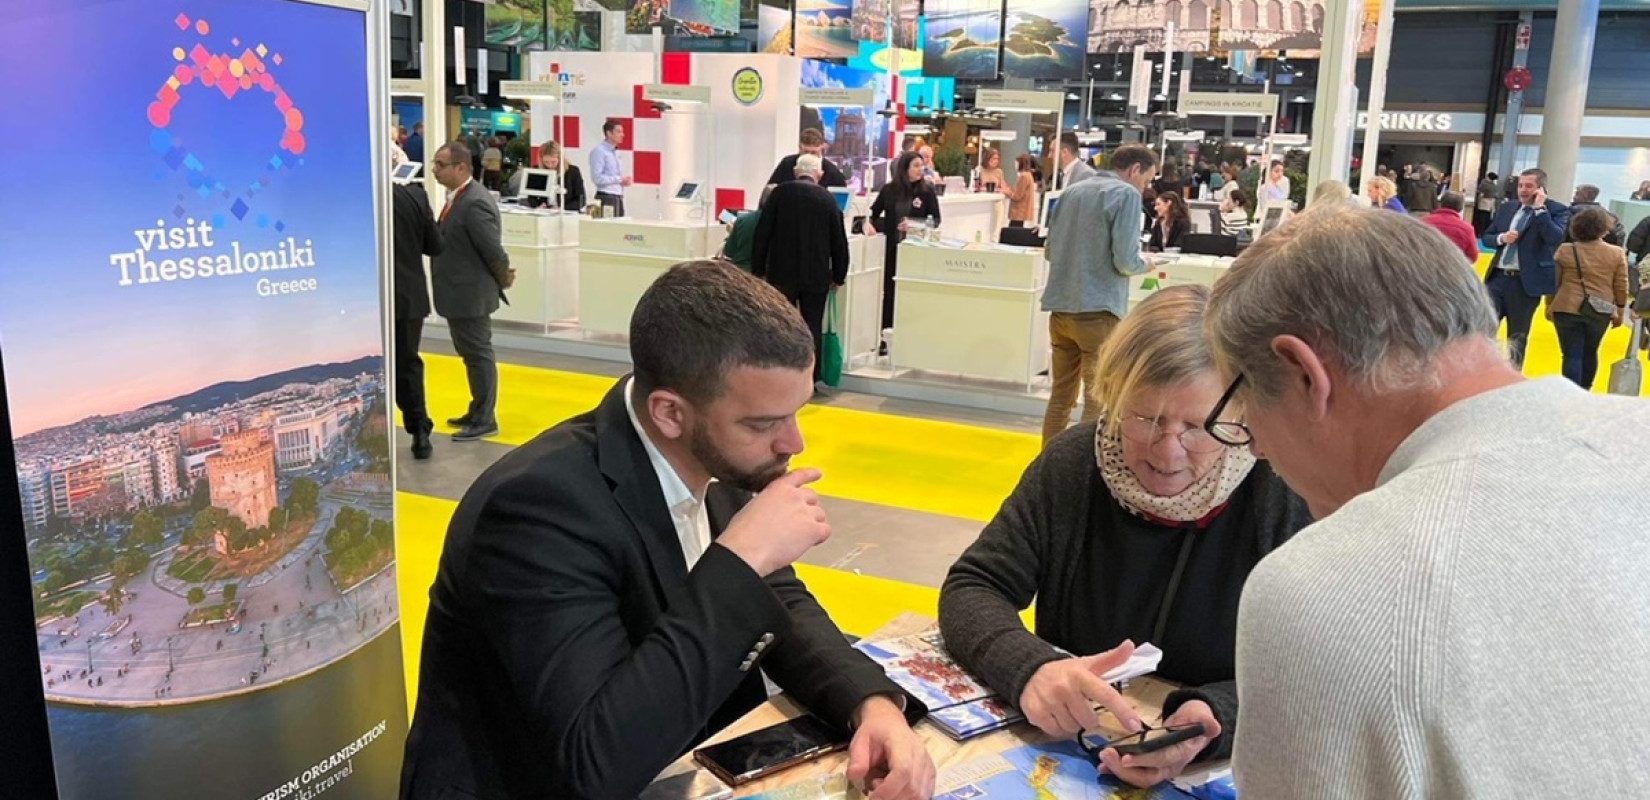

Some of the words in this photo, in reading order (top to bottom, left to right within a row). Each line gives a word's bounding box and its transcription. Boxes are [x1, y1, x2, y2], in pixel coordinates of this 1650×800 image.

[1184, 99, 1221, 107] CAMPINGS
[1356, 112, 1452, 130] DRINKS
[134, 218, 214, 252] visit
[109, 237, 316, 286] Thessaloniki
[256, 278, 318, 297] Greece
[257, 776, 301, 800] RISM
[301, 719, 387, 784] ORGANISATION
